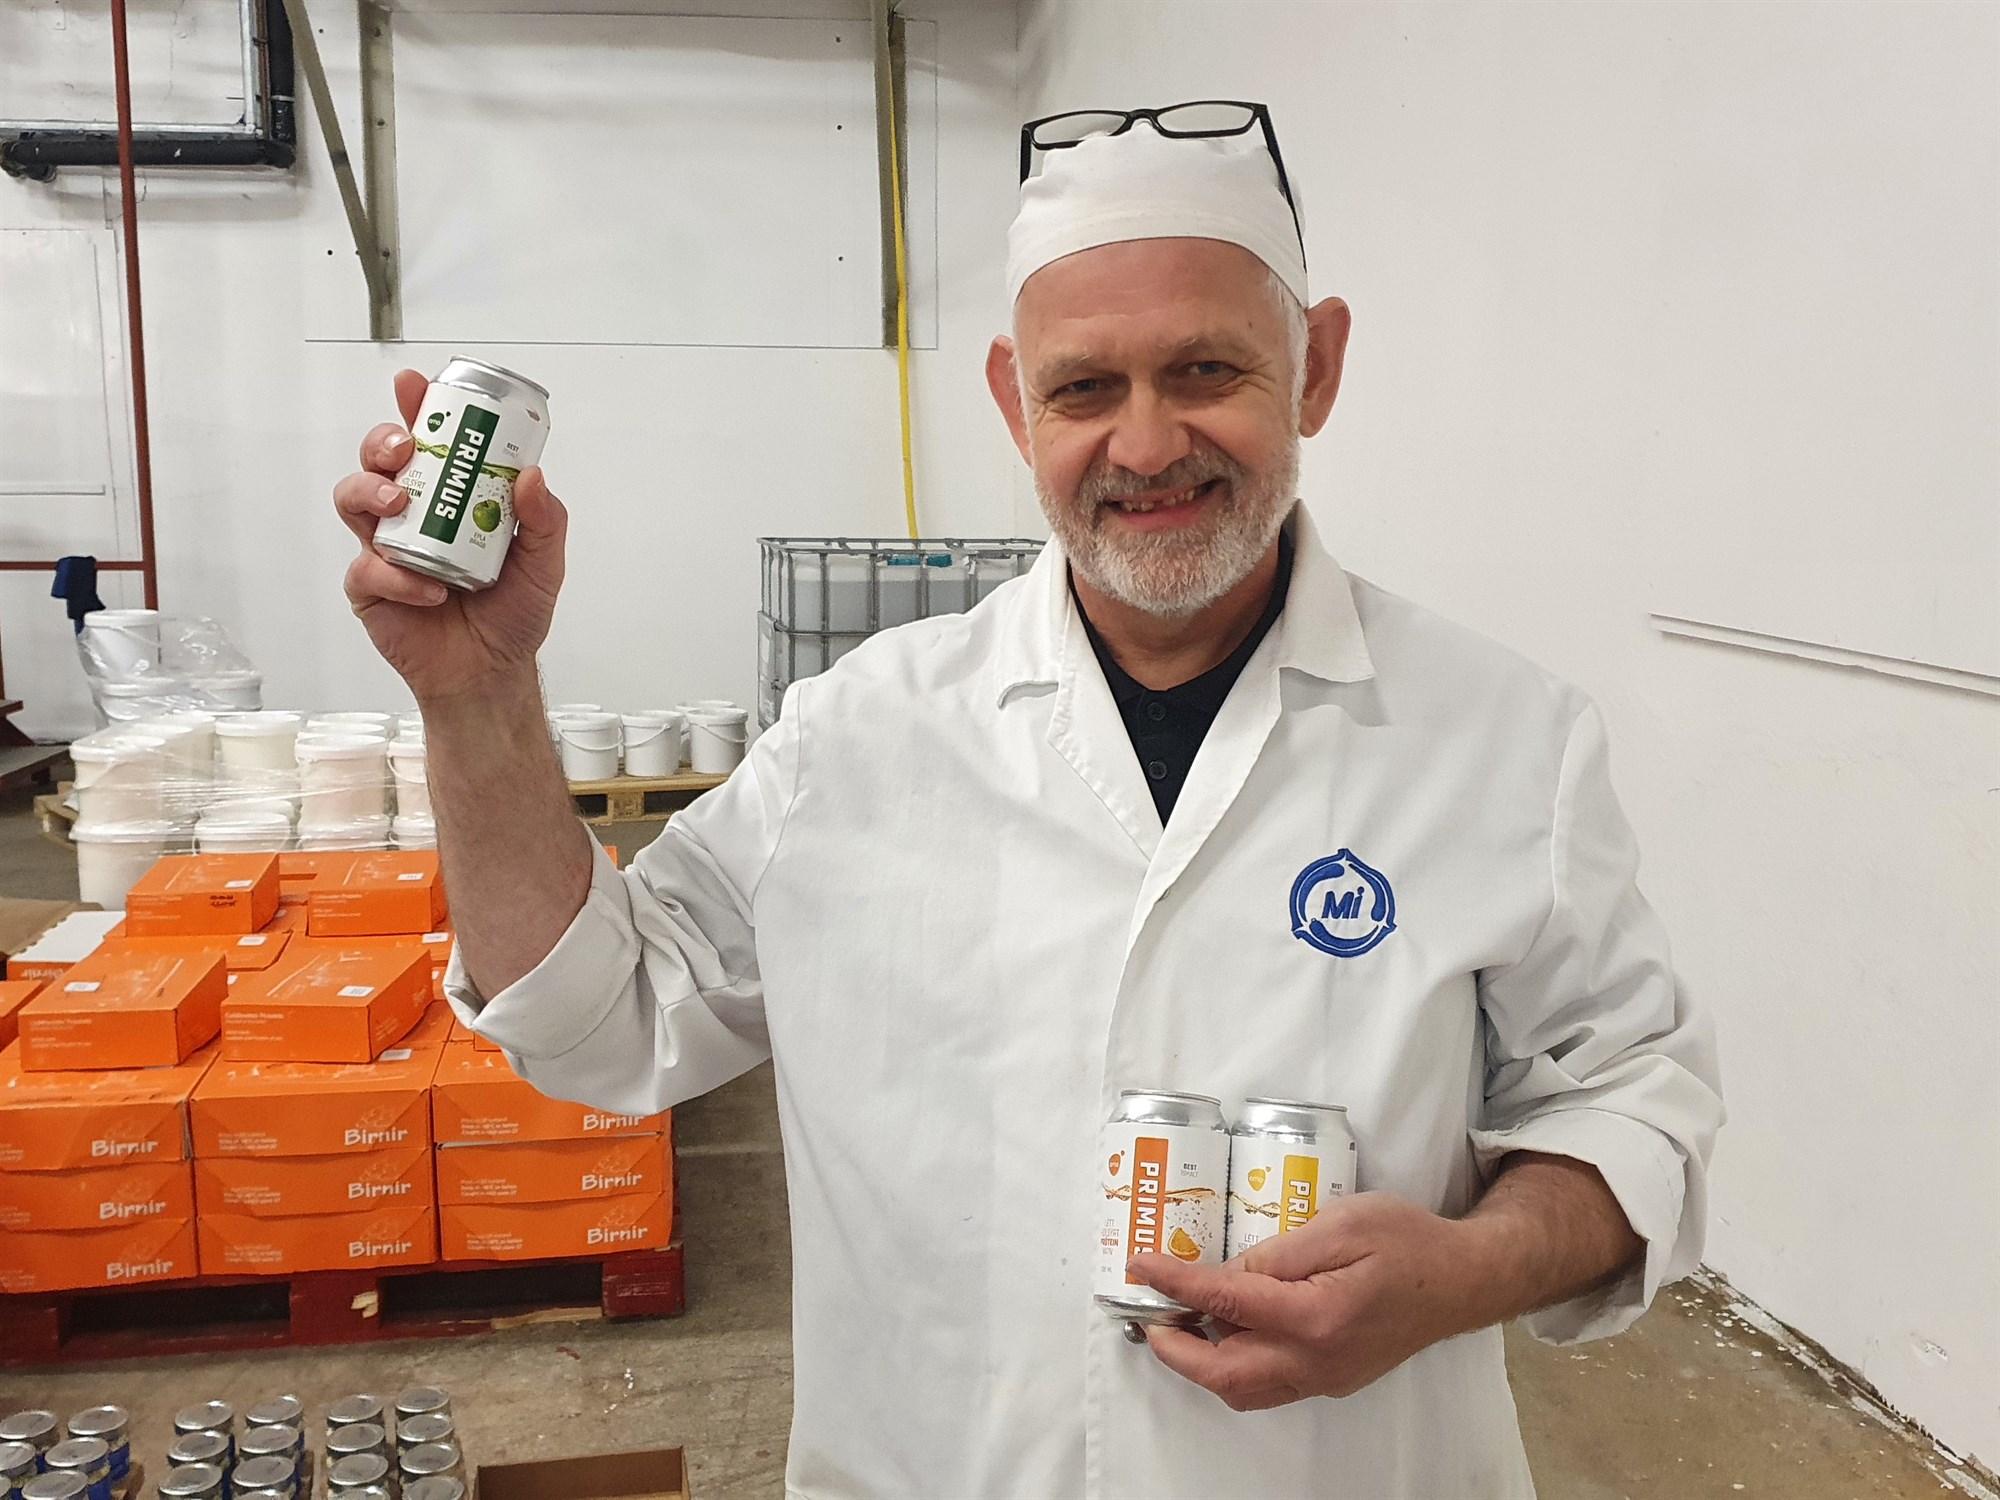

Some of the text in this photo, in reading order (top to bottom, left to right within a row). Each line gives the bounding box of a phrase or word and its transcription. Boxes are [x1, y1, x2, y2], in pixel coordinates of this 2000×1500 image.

[433, 427, 486, 521] PRIMUS
[1321, 886, 1365, 919] Mi
[583, 1114, 645, 1131] Birnir
[344, 1127, 408, 1146] Birnir
[91, 1139, 159, 1157] Birnir
[348, 1181, 412, 1199] Birnir
[581, 1172, 643, 1191] Birnir
[99, 1199, 167, 1220] Birnir
[1286, 1180, 1311, 1231] PRI
[587, 1225, 648, 1245] Birnir
[348, 1240, 412, 1258] Birnir
[106, 1258, 174, 1280] Birnir
